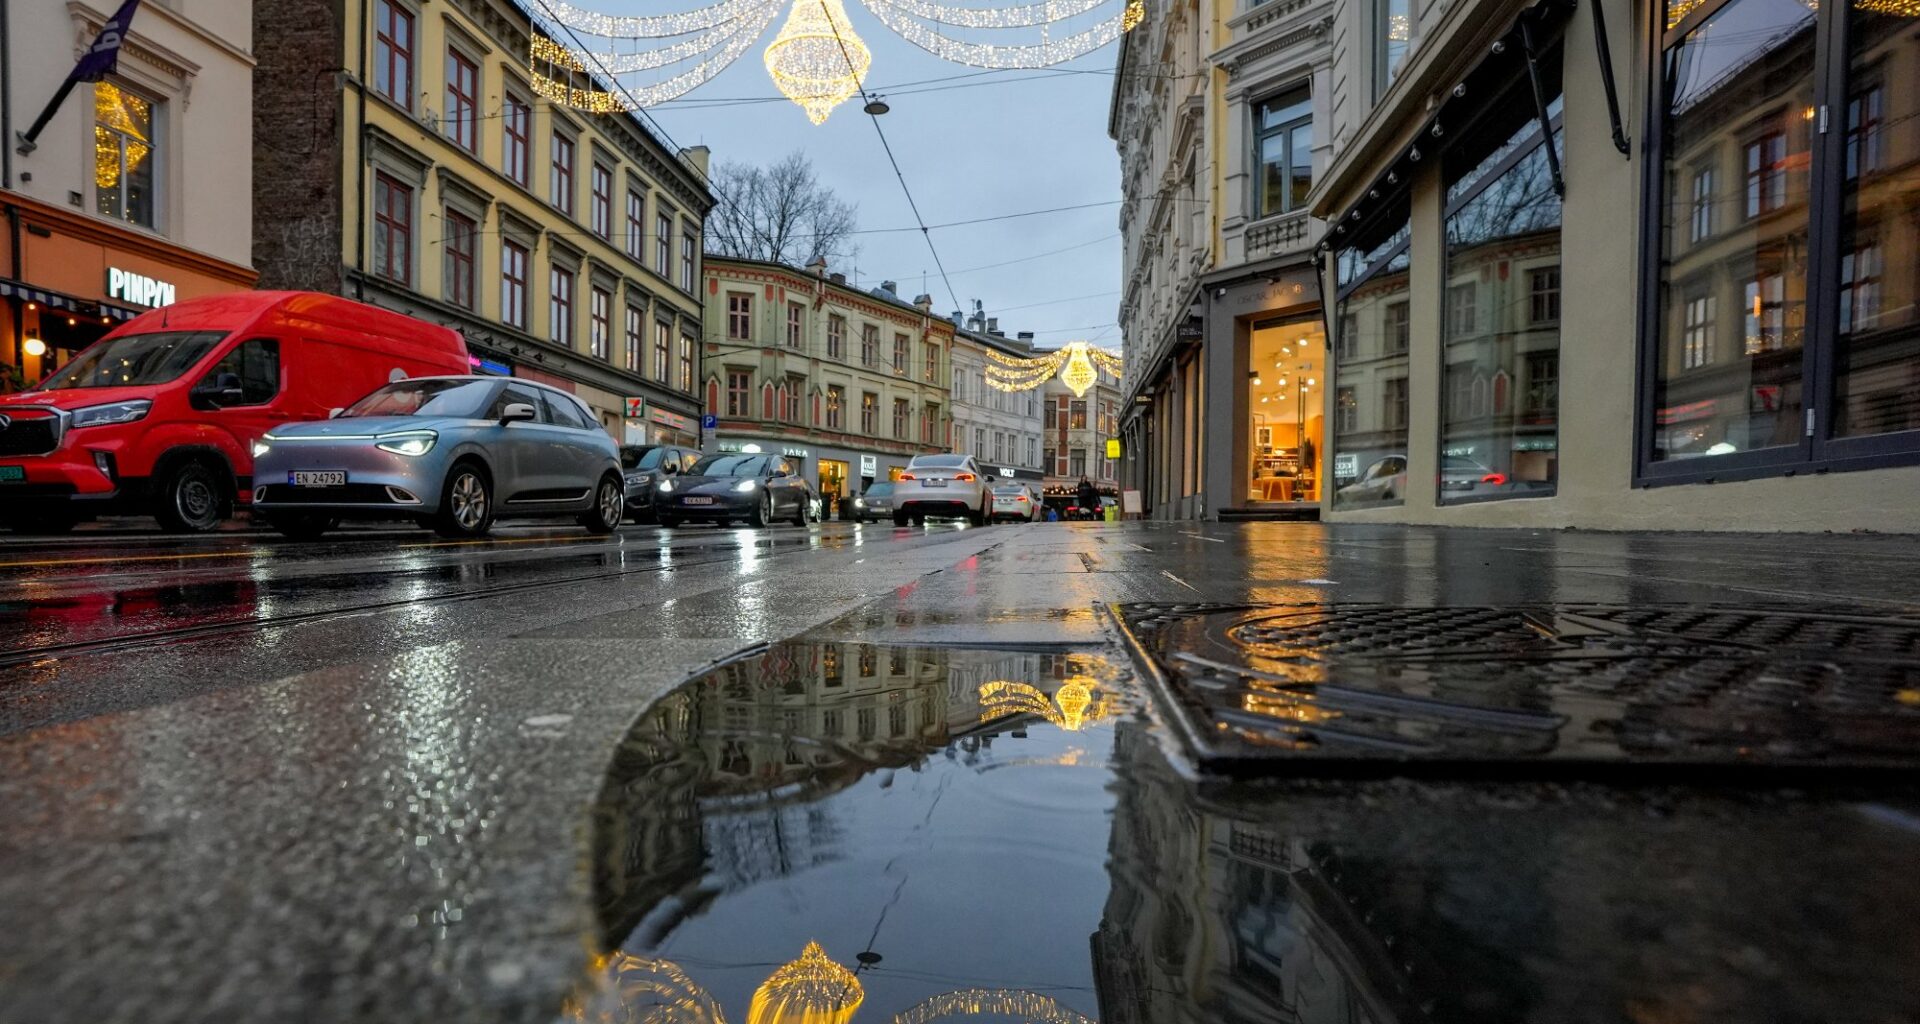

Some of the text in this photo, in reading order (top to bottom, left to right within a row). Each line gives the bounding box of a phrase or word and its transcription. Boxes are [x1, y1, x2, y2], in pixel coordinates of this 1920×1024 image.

[705, 416, 714, 428] P
[999, 467, 1016, 478] VOLT
[296, 473, 343, 484] EN 24792
